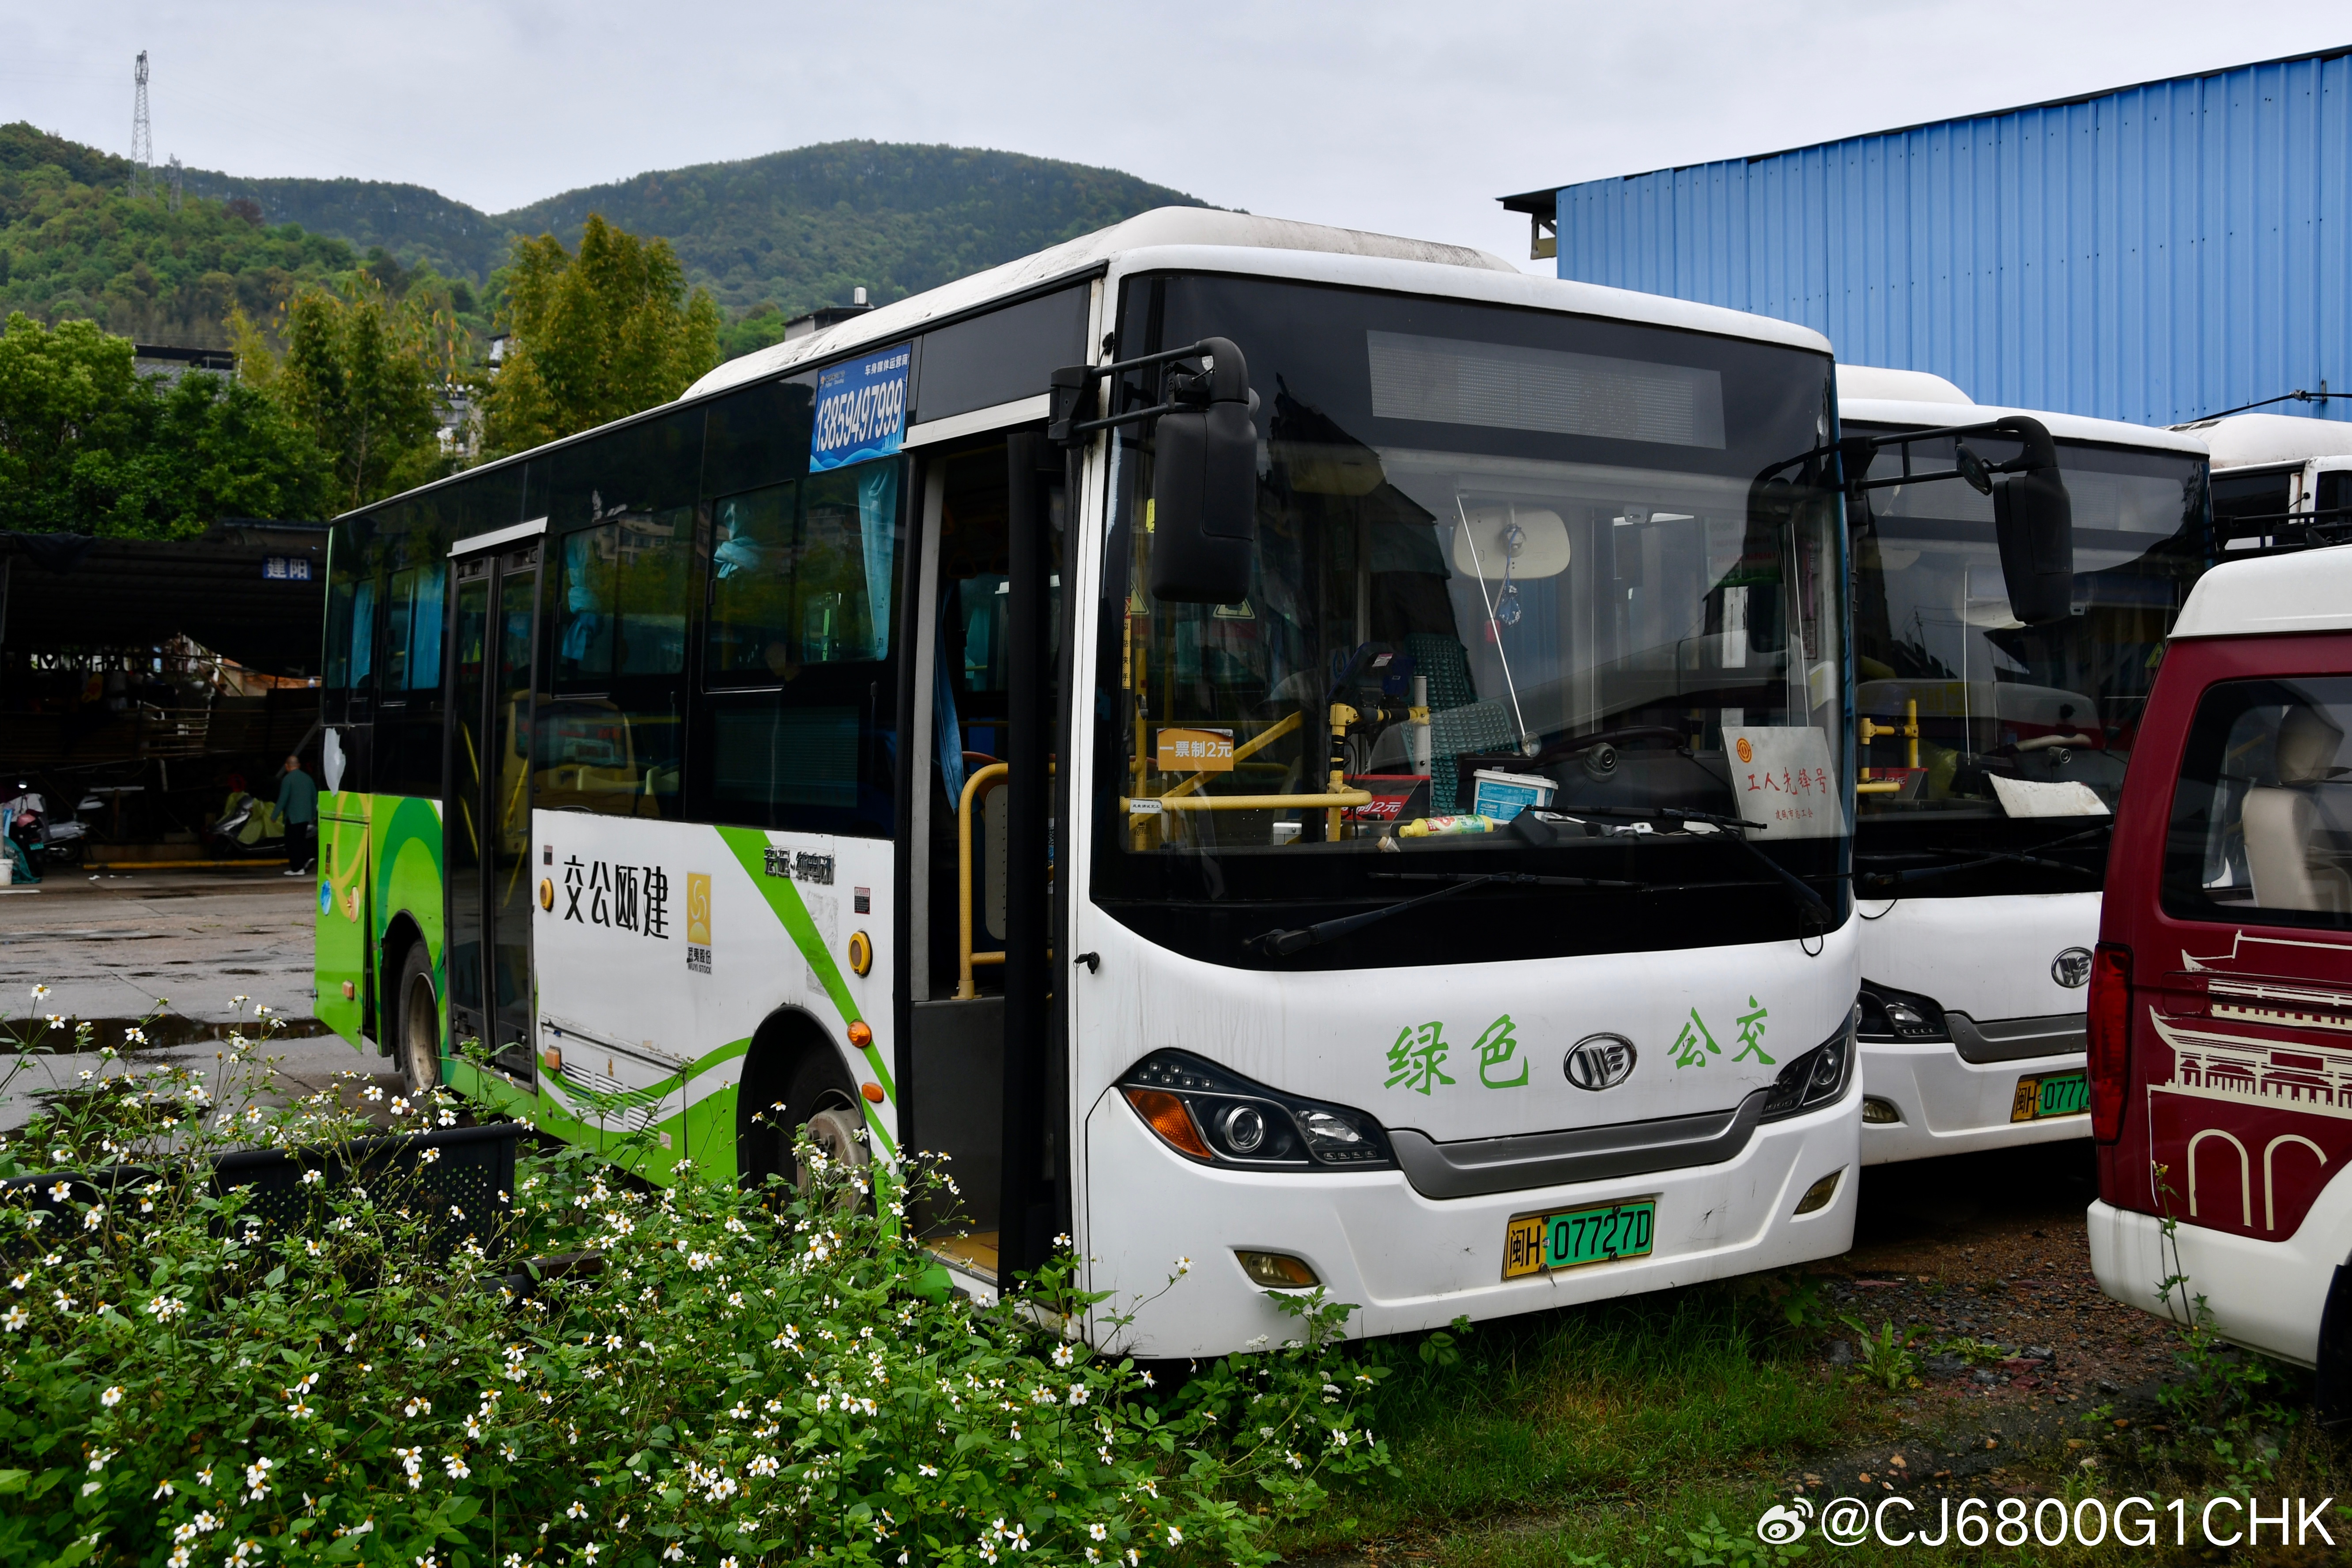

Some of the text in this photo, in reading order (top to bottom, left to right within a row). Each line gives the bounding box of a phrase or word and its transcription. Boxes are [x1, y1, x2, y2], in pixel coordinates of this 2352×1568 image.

[816, 378, 903, 452] 13859497999
[268, 557, 308, 578] 建阳
[1159, 741, 1232, 758] 一票制2元
[1748, 767, 1827, 796] 工人先锋号
[687, 947, 711, 964] 武夷股份
[688, 963, 712, 975] WUYI STOCK
[1383, 994, 1777, 1096] 绿色 公交
